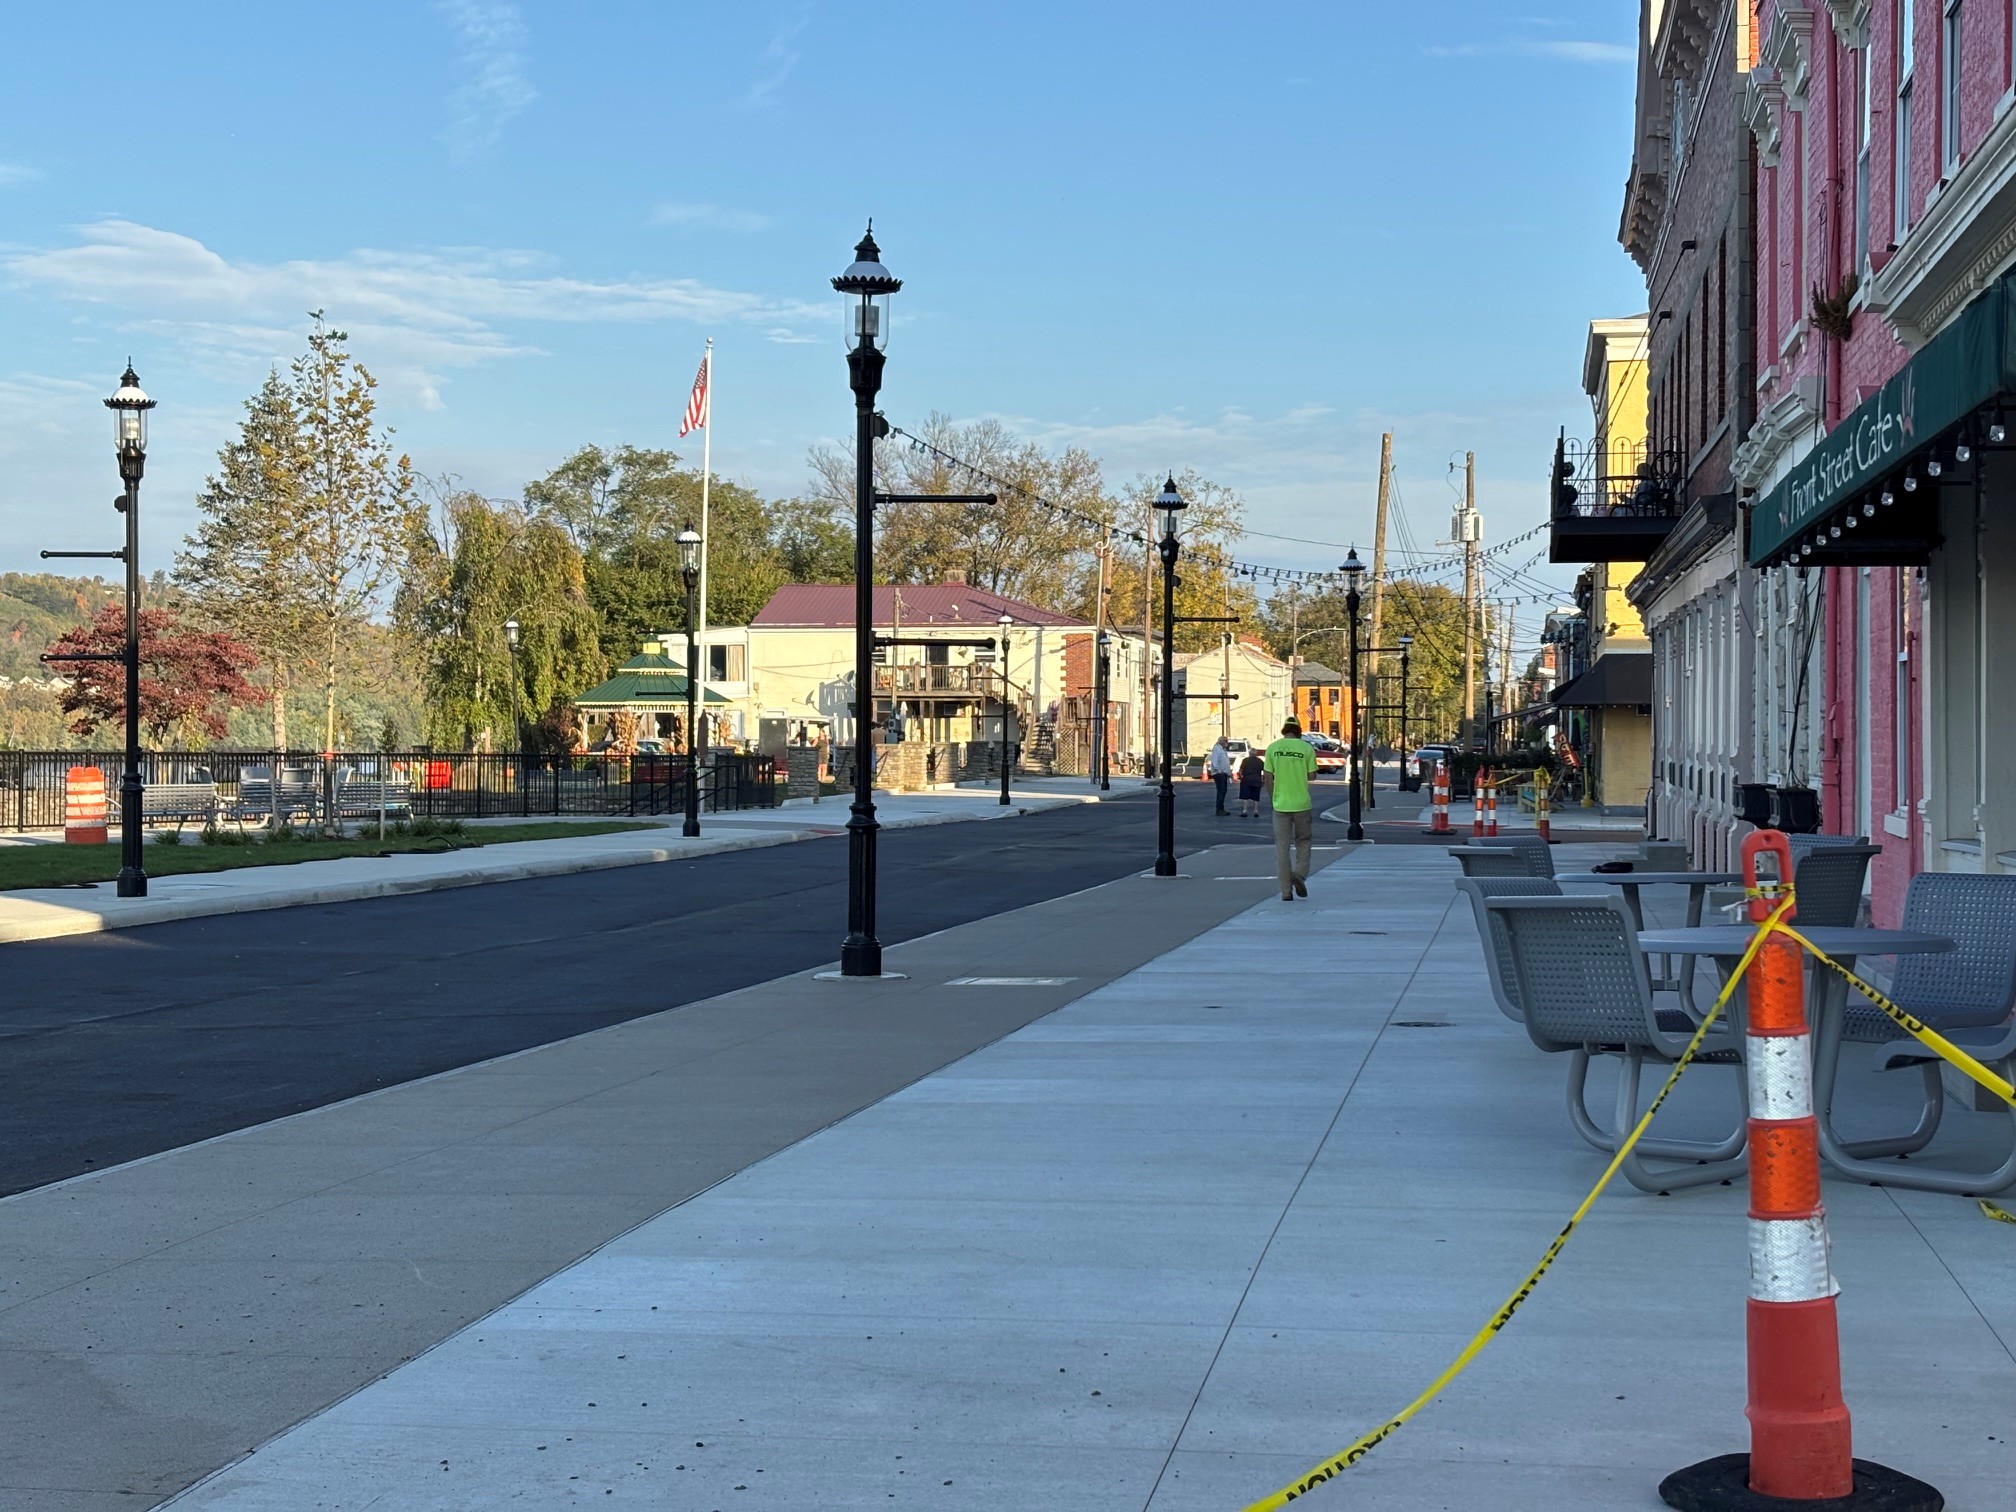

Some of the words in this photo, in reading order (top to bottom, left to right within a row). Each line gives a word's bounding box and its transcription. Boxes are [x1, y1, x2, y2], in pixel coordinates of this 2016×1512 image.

[1790, 464, 1817, 524] Front
[1818, 432, 1854, 502] Street
[1855, 384, 1893, 471] Cafe
